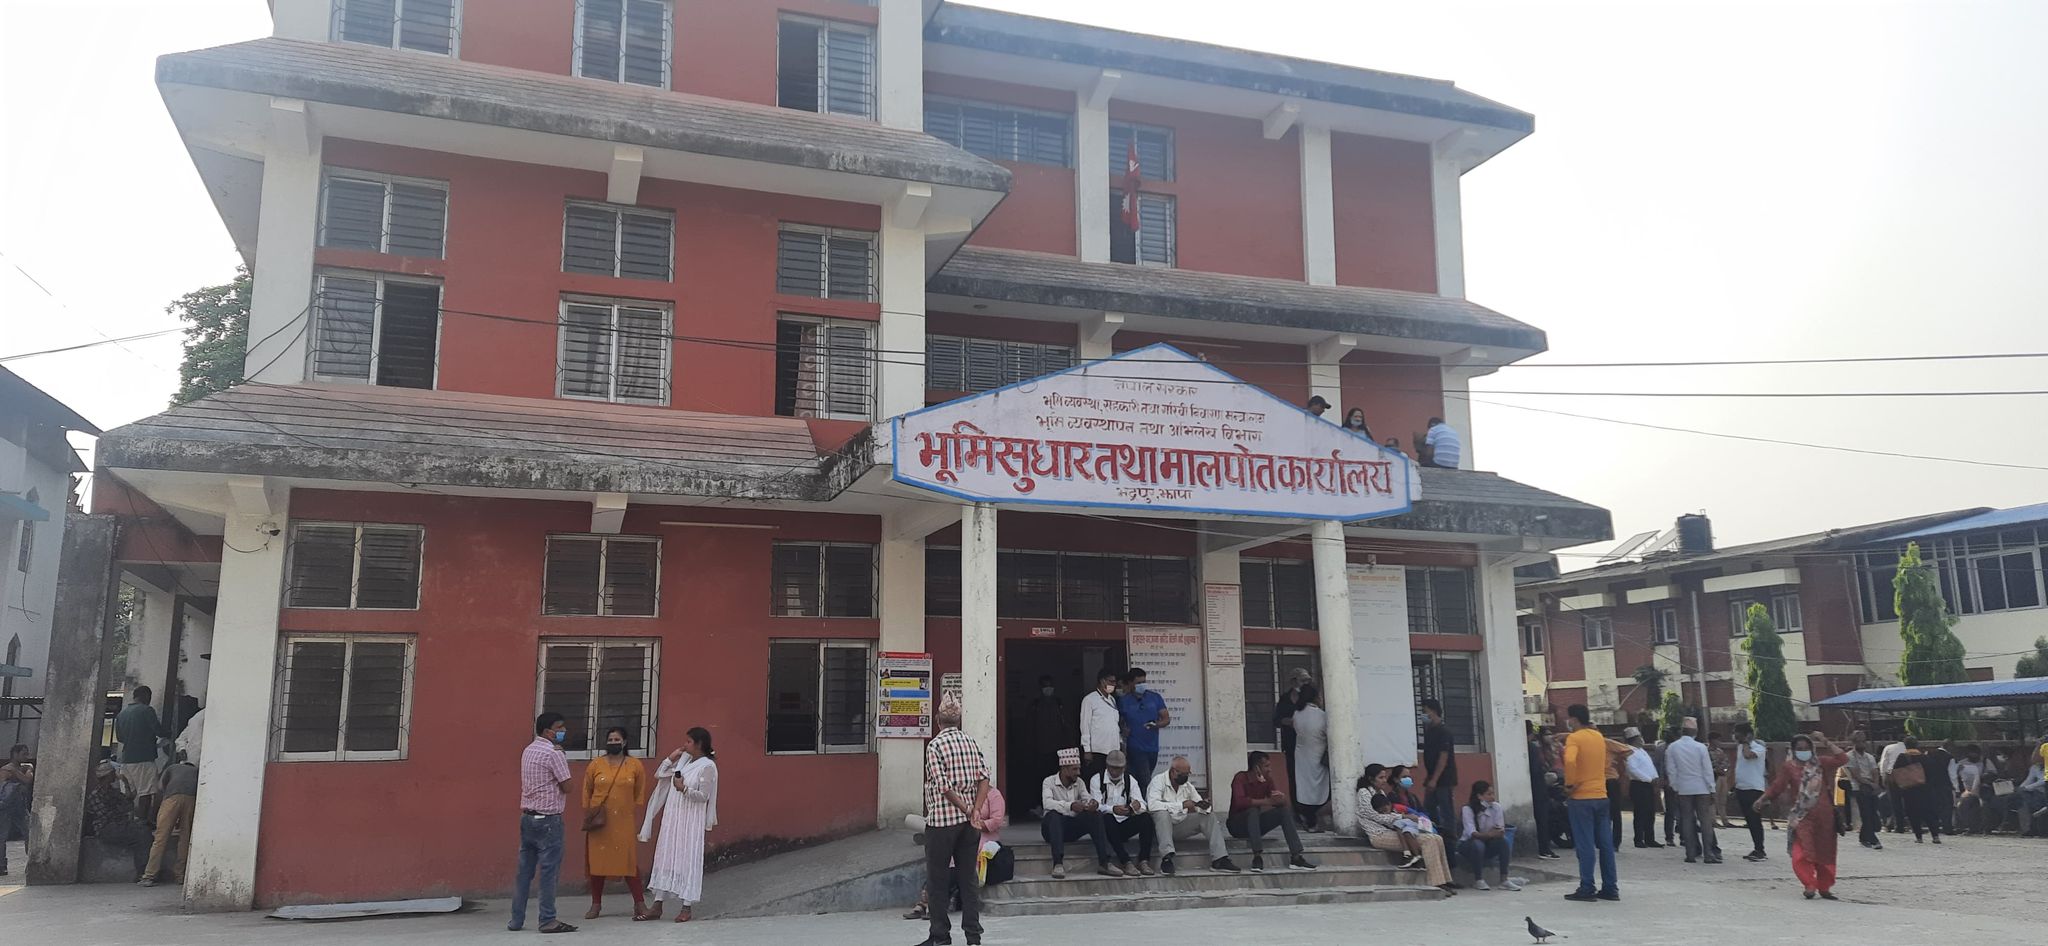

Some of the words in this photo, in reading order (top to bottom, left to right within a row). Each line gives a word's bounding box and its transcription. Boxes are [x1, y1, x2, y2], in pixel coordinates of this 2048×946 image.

[1141, 402, 1160, 415] तथा
[1067, 416, 1135, 433] व्यवस्थापन
[1139, 421, 1165, 435] तथा
[1222, 423, 1263, 442] विभाग
